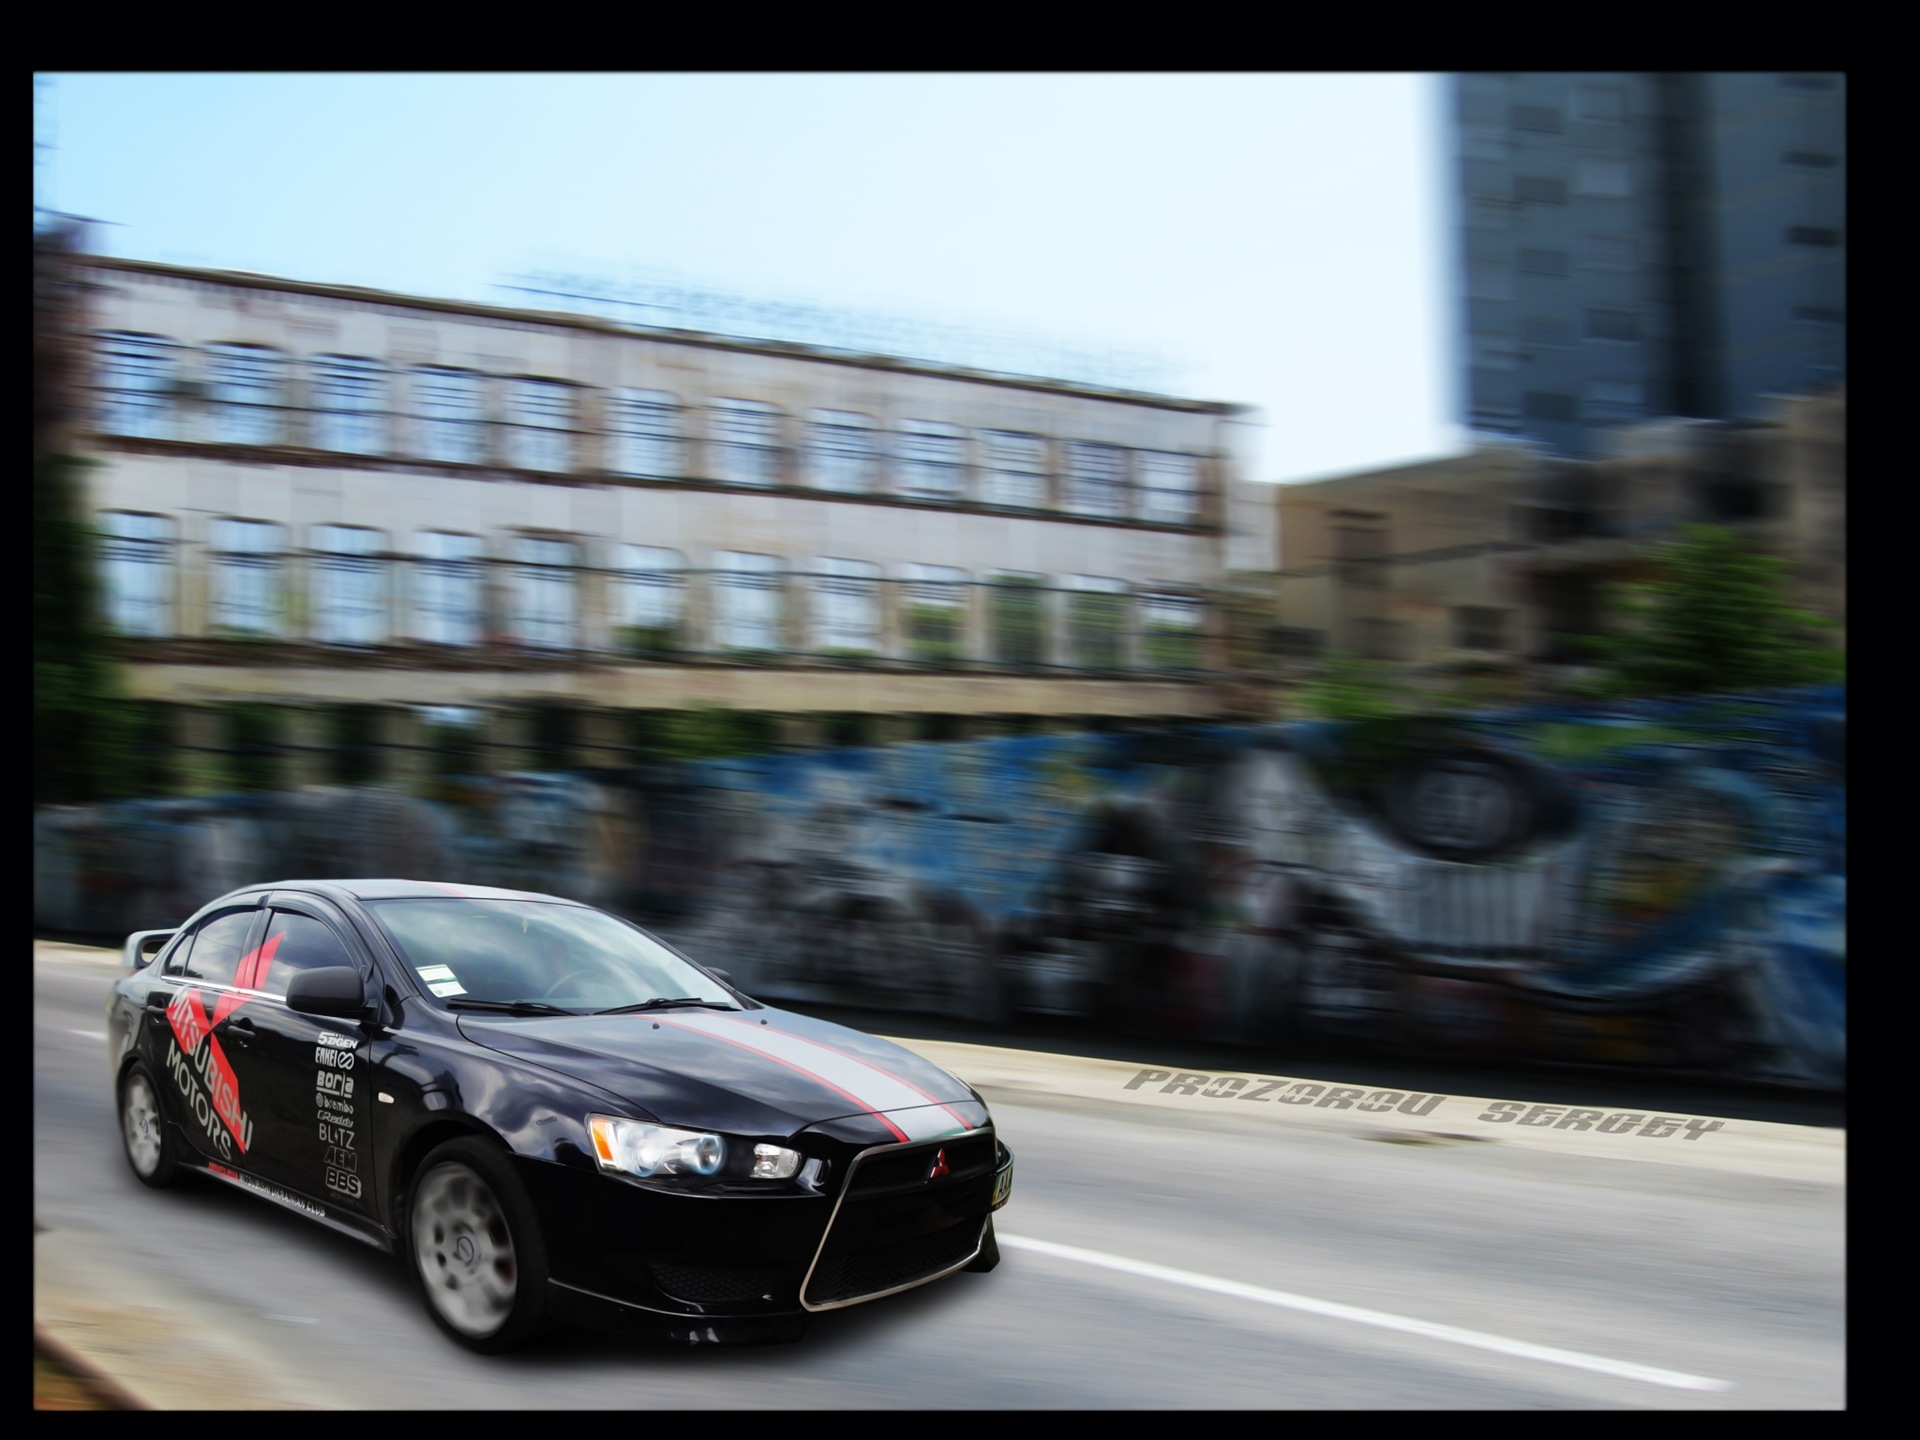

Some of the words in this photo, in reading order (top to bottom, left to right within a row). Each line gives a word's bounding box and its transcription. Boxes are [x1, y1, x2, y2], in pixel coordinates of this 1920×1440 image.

[166, 1037, 232, 1162] MOTORS
[168, 984, 254, 1152] MITSUBISHI
[325, 1166, 361, 1199] BBS
